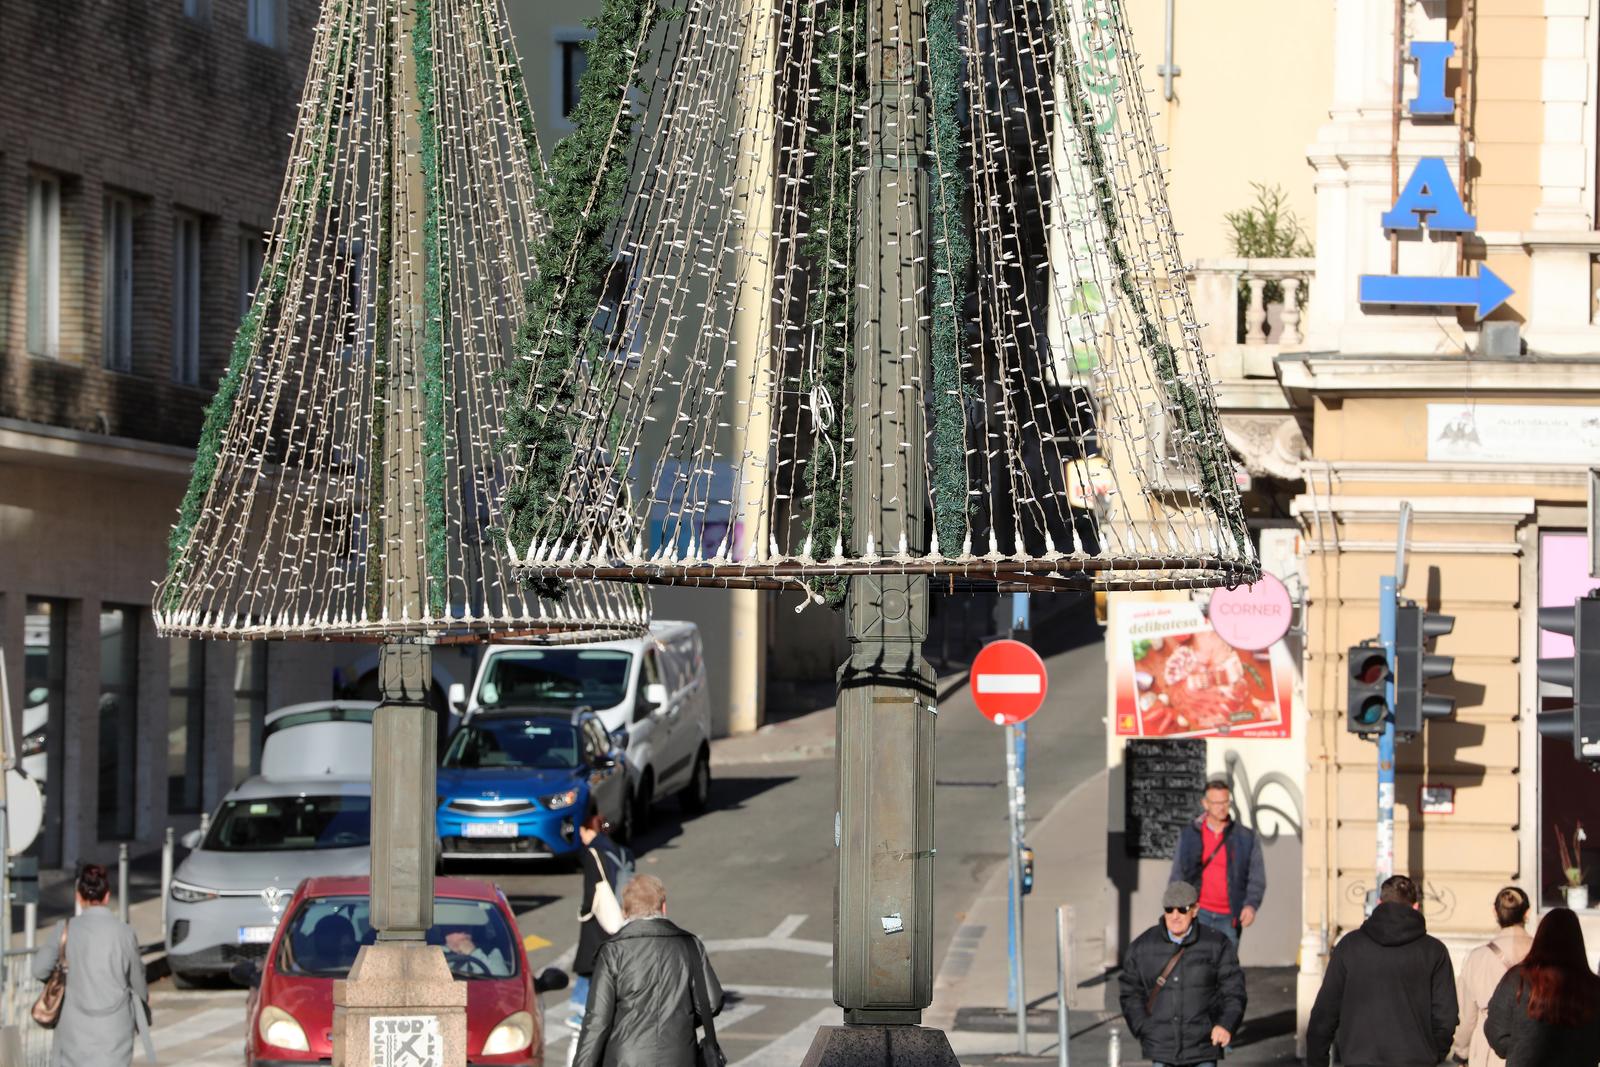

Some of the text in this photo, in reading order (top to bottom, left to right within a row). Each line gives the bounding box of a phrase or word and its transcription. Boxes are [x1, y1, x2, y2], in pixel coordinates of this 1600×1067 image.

[1220, 602, 1281, 616] CORNER
[1129, 618, 1198, 634] delikatesa
[374, 1020, 424, 1033] STOP
